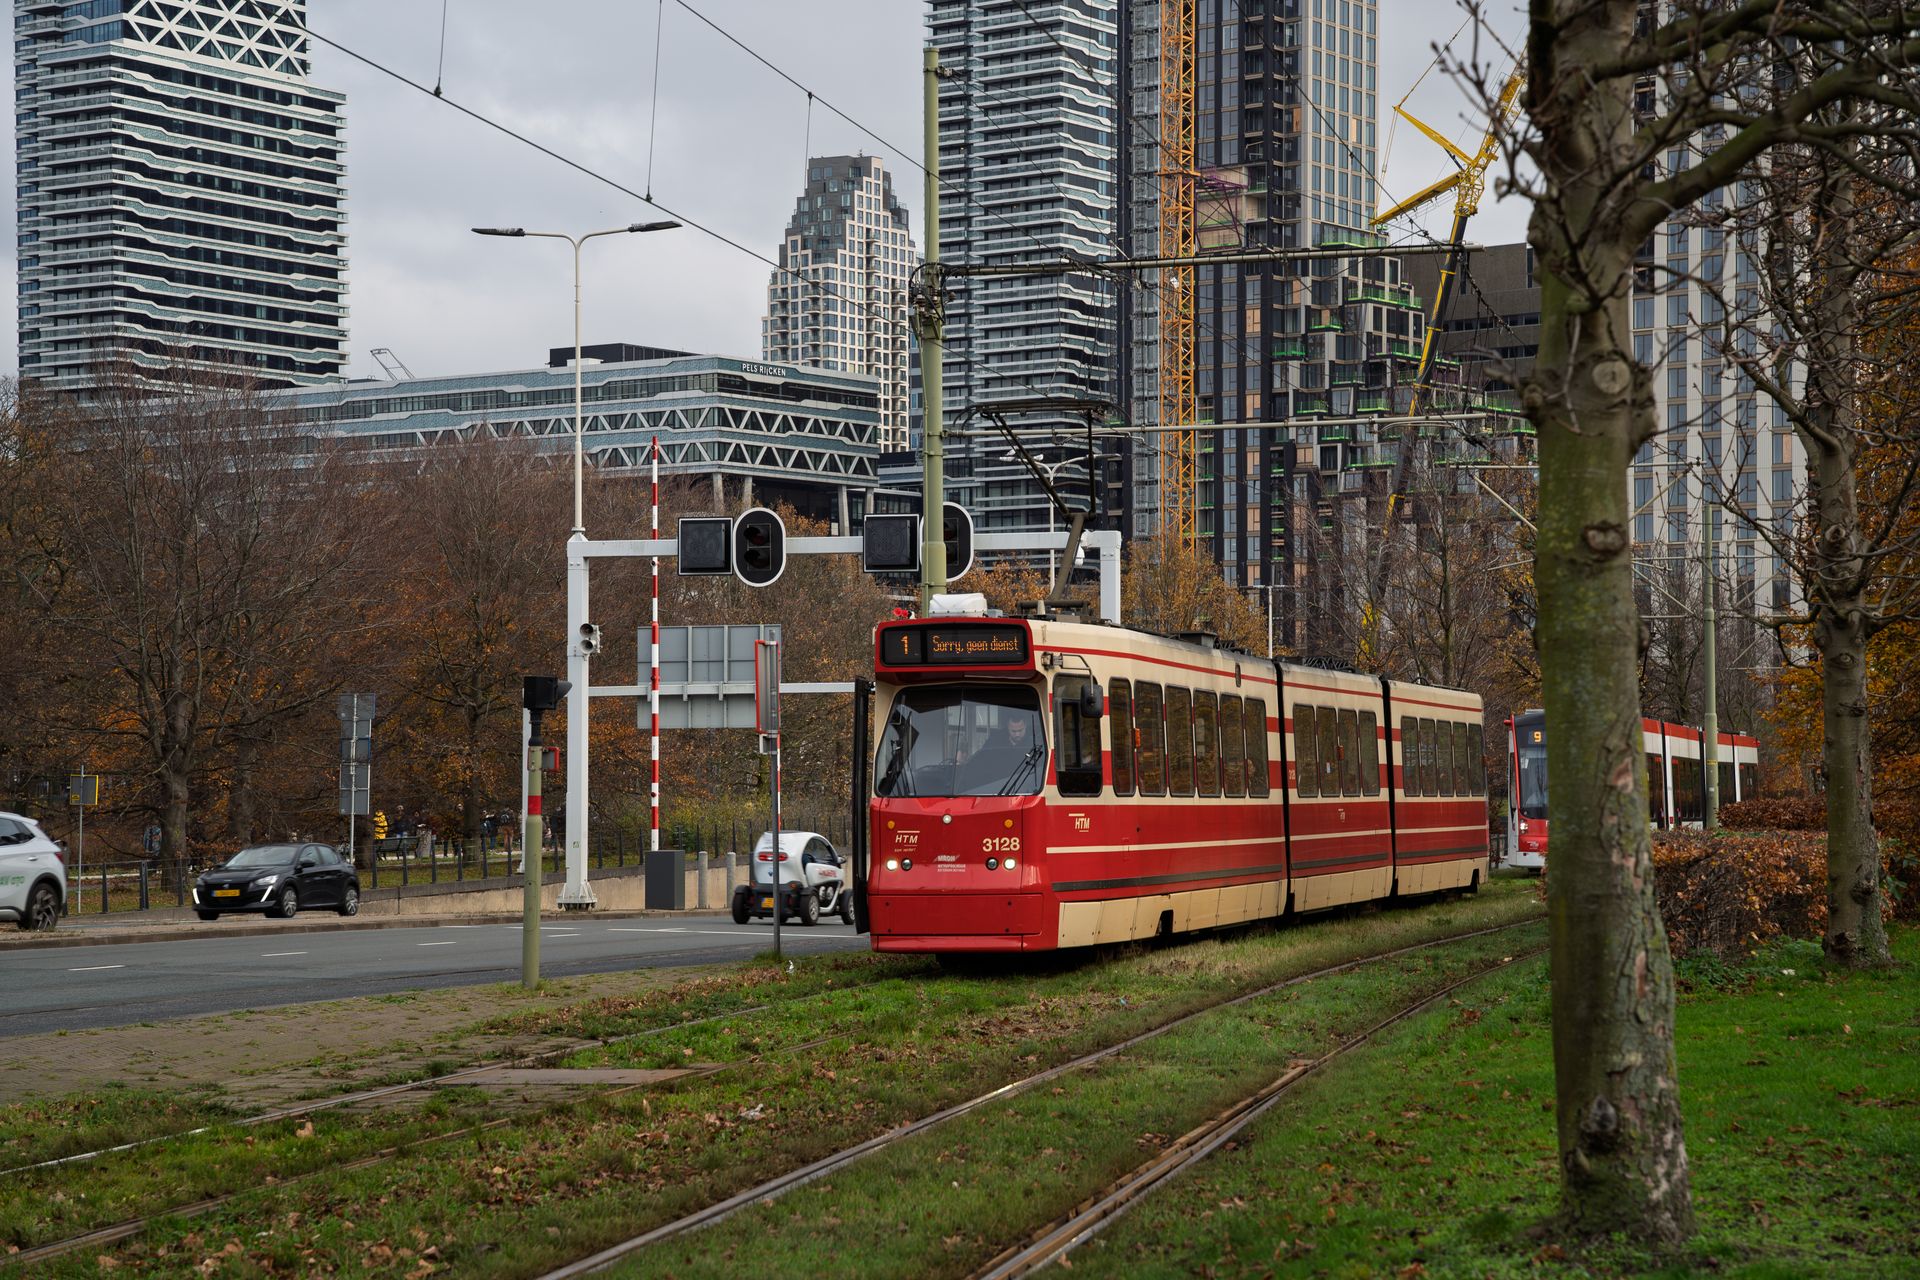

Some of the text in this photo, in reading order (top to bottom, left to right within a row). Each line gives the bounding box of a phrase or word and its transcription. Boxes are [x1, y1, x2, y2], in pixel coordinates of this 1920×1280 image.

[742, 363, 757, 372] PELS
[901, 635, 909, 655] 1
[932, 635, 1019, 654] Sorry, geen dienst
[1534, 731, 1541, 742] 9
[1075, 817, 1090, 830] HTM
[895, 834, 918, 844] HTM
[982, 837, 1020, 852] 3128
